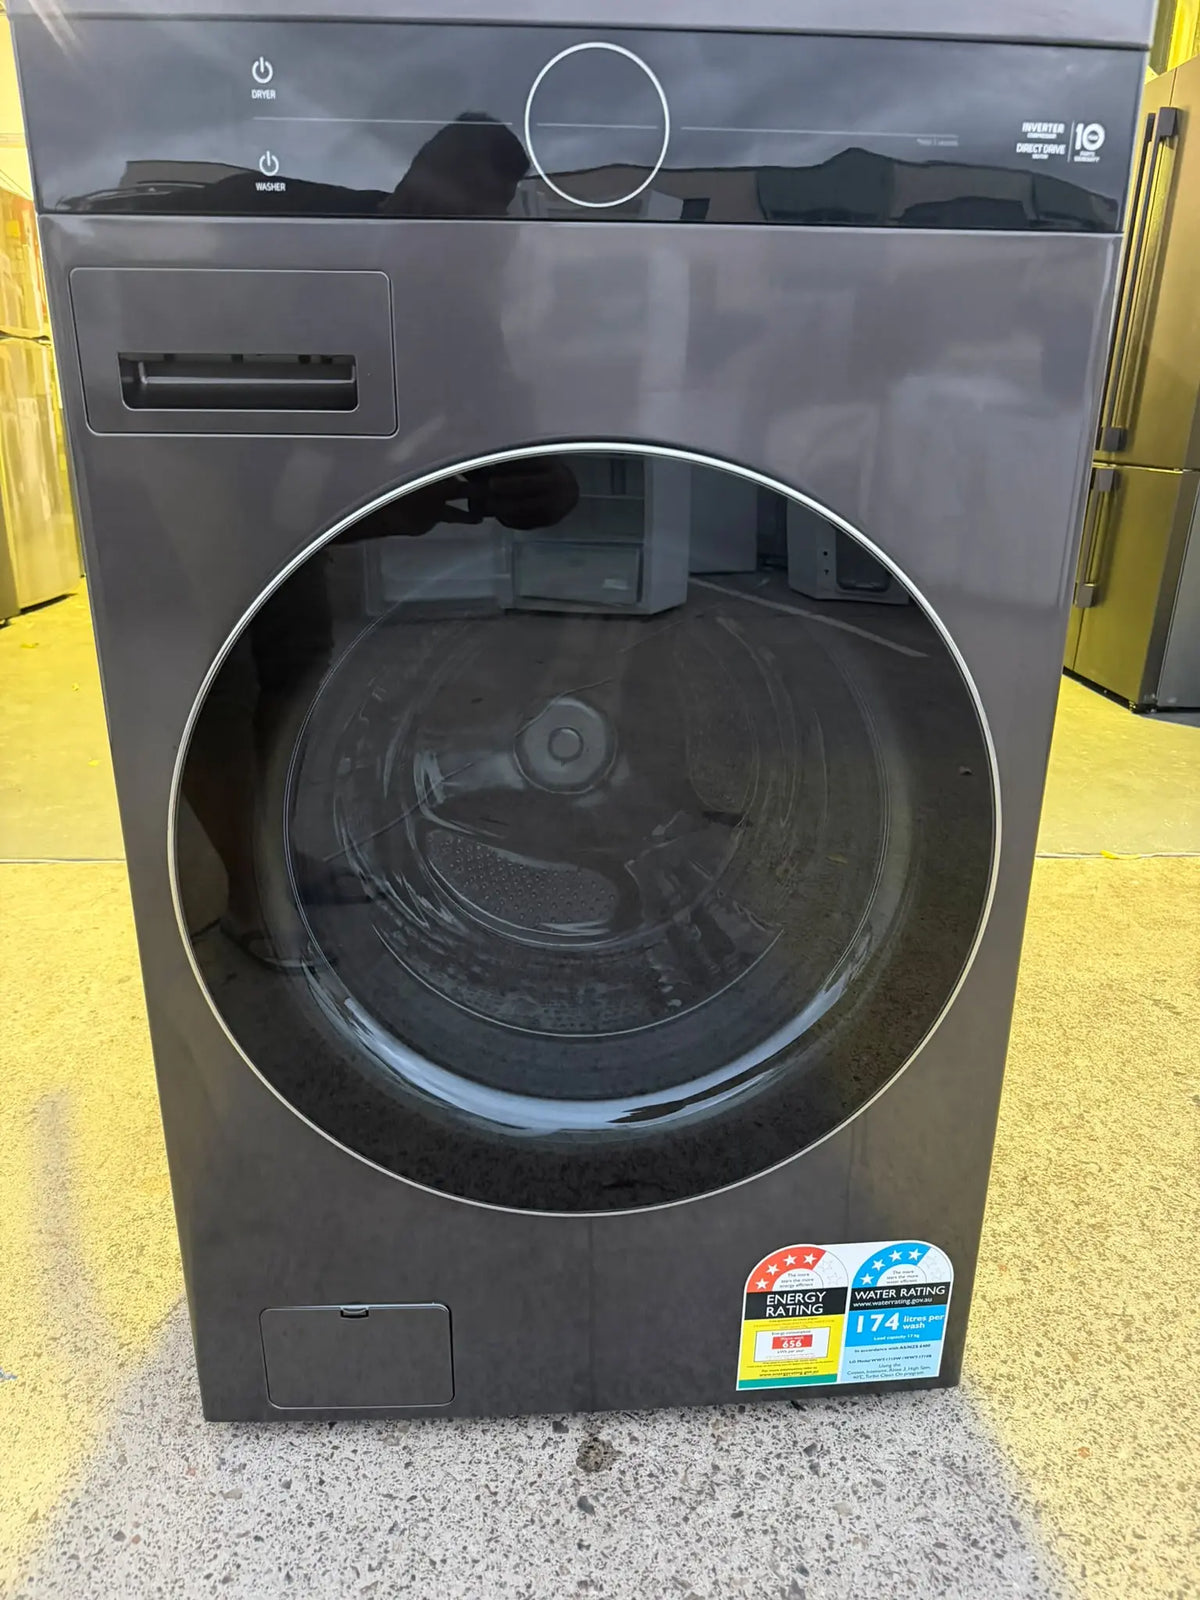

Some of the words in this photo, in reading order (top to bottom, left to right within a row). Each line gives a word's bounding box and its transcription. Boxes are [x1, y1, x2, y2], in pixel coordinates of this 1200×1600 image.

[251, 89, 276, 99] DRYER
[1022, 122, 1065, 133] INVERTER
[1075, 123, 1105, 151] 10
[1016, 143, 1043, 154] DIRECT
[1043, 144, 1066, 155] DRIVE
[255, 182, 286, 191] WASHER
[766, 1291, 826, 1305] ENERGY
[855, 1288, 897, 1300] WATER
[900, 1285, 946, 1297] RATING
[852, 1298, 933, 1307] www.waterrating.gov.au
[766, 1304, 823, 1317] RATING
[857, 1312, 900, 1333] 174
[904, 1315, 927, 1323] litres
[928, 1314, 945, 1322] per
[902, 1322, 925, 1330] wash
[782, 1340, 802, 1349] 656
